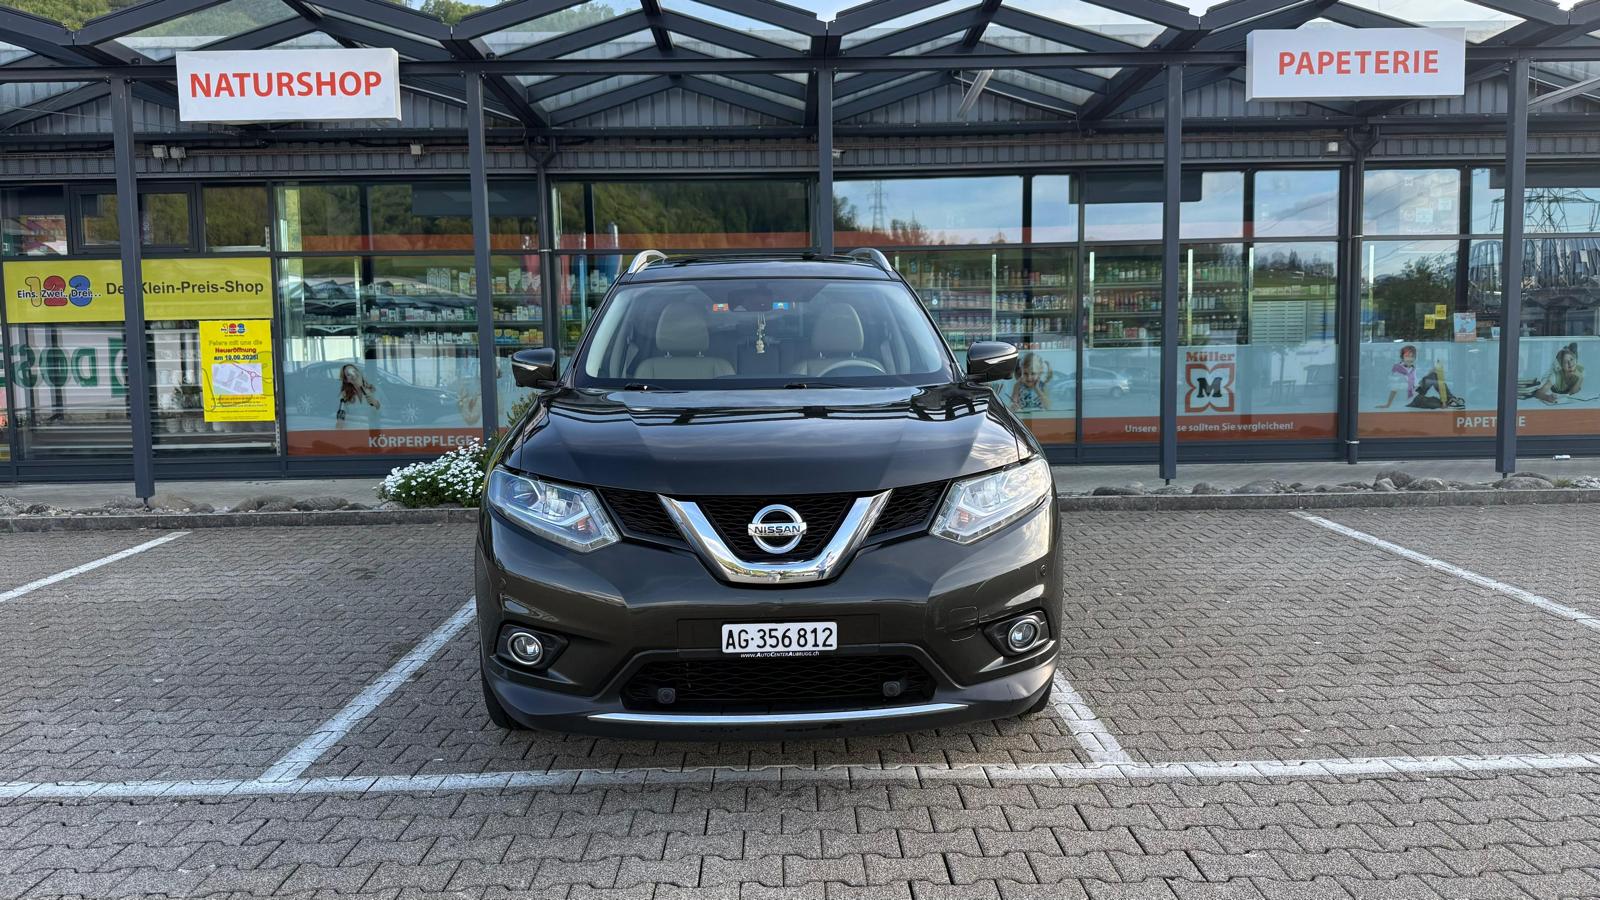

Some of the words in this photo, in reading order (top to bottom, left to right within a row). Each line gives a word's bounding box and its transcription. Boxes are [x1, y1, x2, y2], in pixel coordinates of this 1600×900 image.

[1278, 50, 1439, 75] PAPETERIE
[190, 71, 382, 98] NATURSHOP
[17, 289, 38, 298] Eins.
[106, 282, 125, 295] De
[1186, 352, 1235, 362] Müller
[1197, 377, 1223, 397] M
[1188, 421, 1219, 432] sollten
[1222, 422, 1236, 431] Sie
[1237, 421, 1294, 435] vergleichen!
[1456, 416, 1526, 428] PAPETE
[1125, 424, 1157, 433] Unsere
[754, 525, 800, 533] NISSAN
